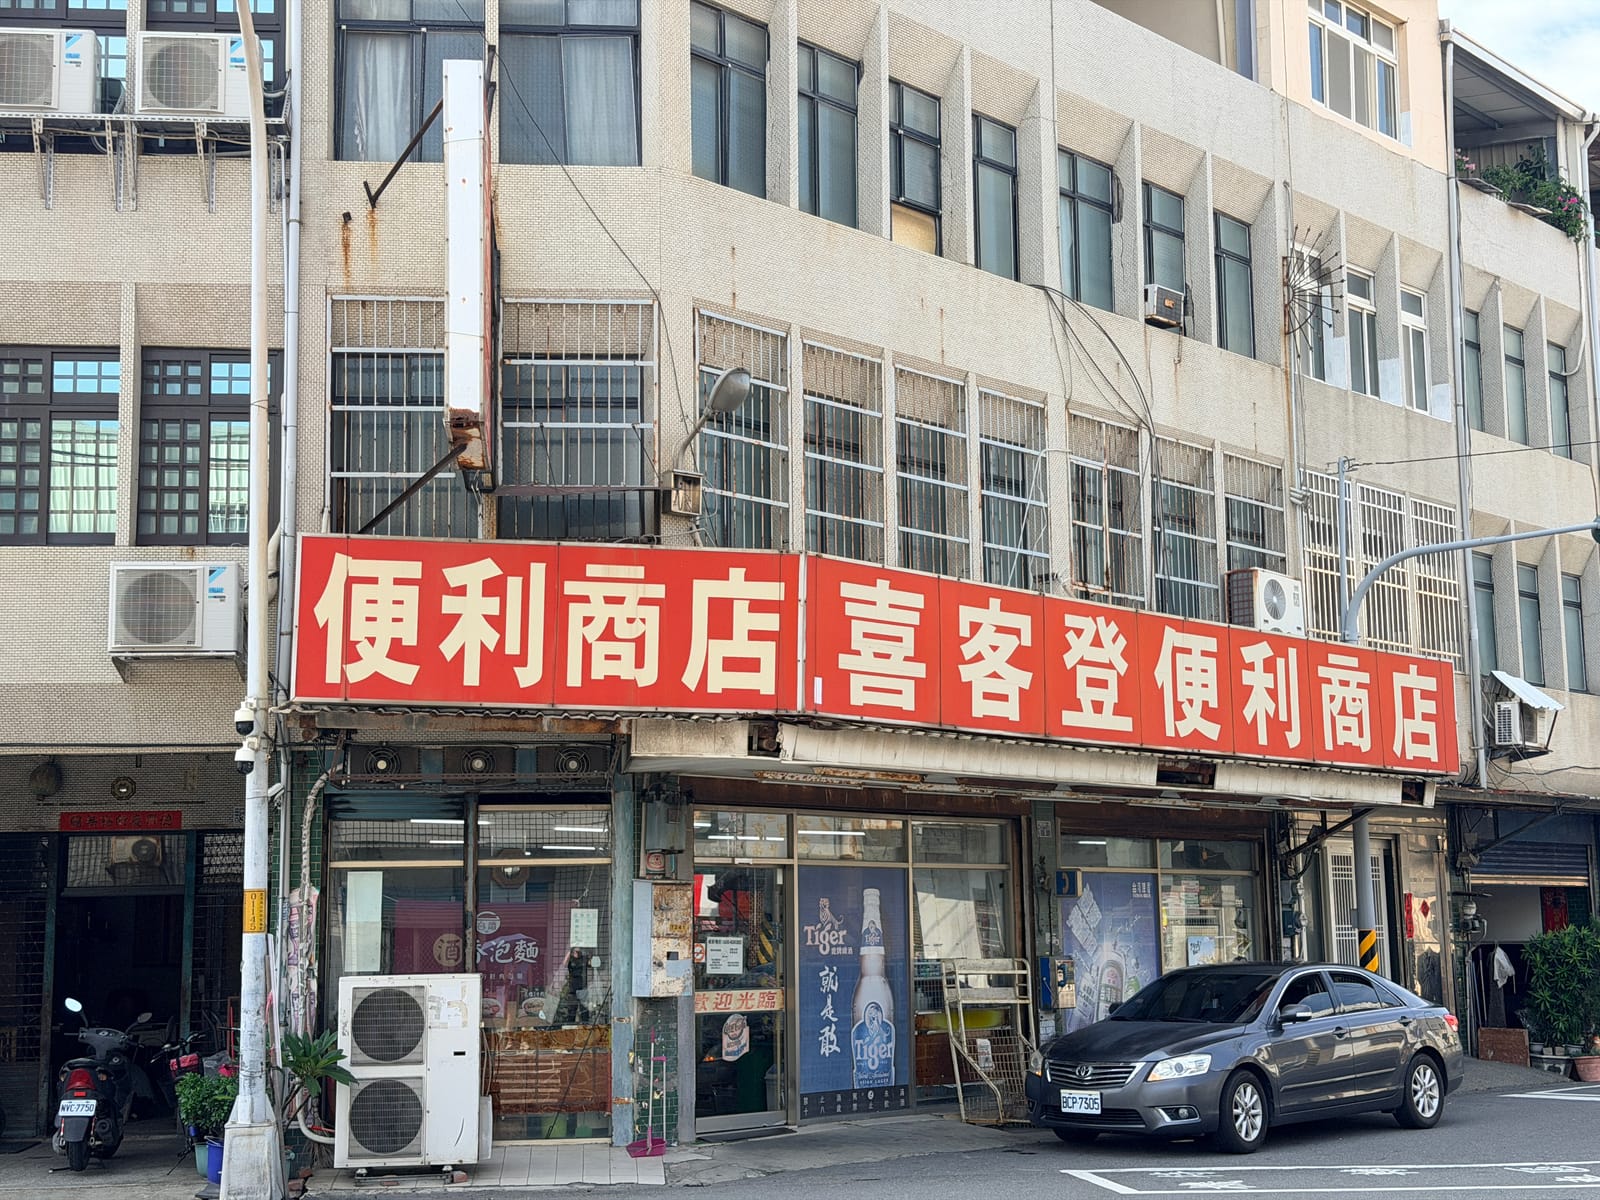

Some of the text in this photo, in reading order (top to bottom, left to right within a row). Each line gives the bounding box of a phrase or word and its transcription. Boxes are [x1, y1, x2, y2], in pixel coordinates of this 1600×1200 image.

[313, 552, 785, 695] 便利商店
[838, 577, 1439, 763] 喜客登便利商店
[804, 922, 847, 955] Tiger
[865, 933, 881, 946] Tiger
[818, 965, 840, 1058] 就是敢
[855, 1036, 895, 1070] Tiger
[60, 1103, 95, 1113] NVC-7750
[1062, 1096, 1100, 1111] BCP-7305
